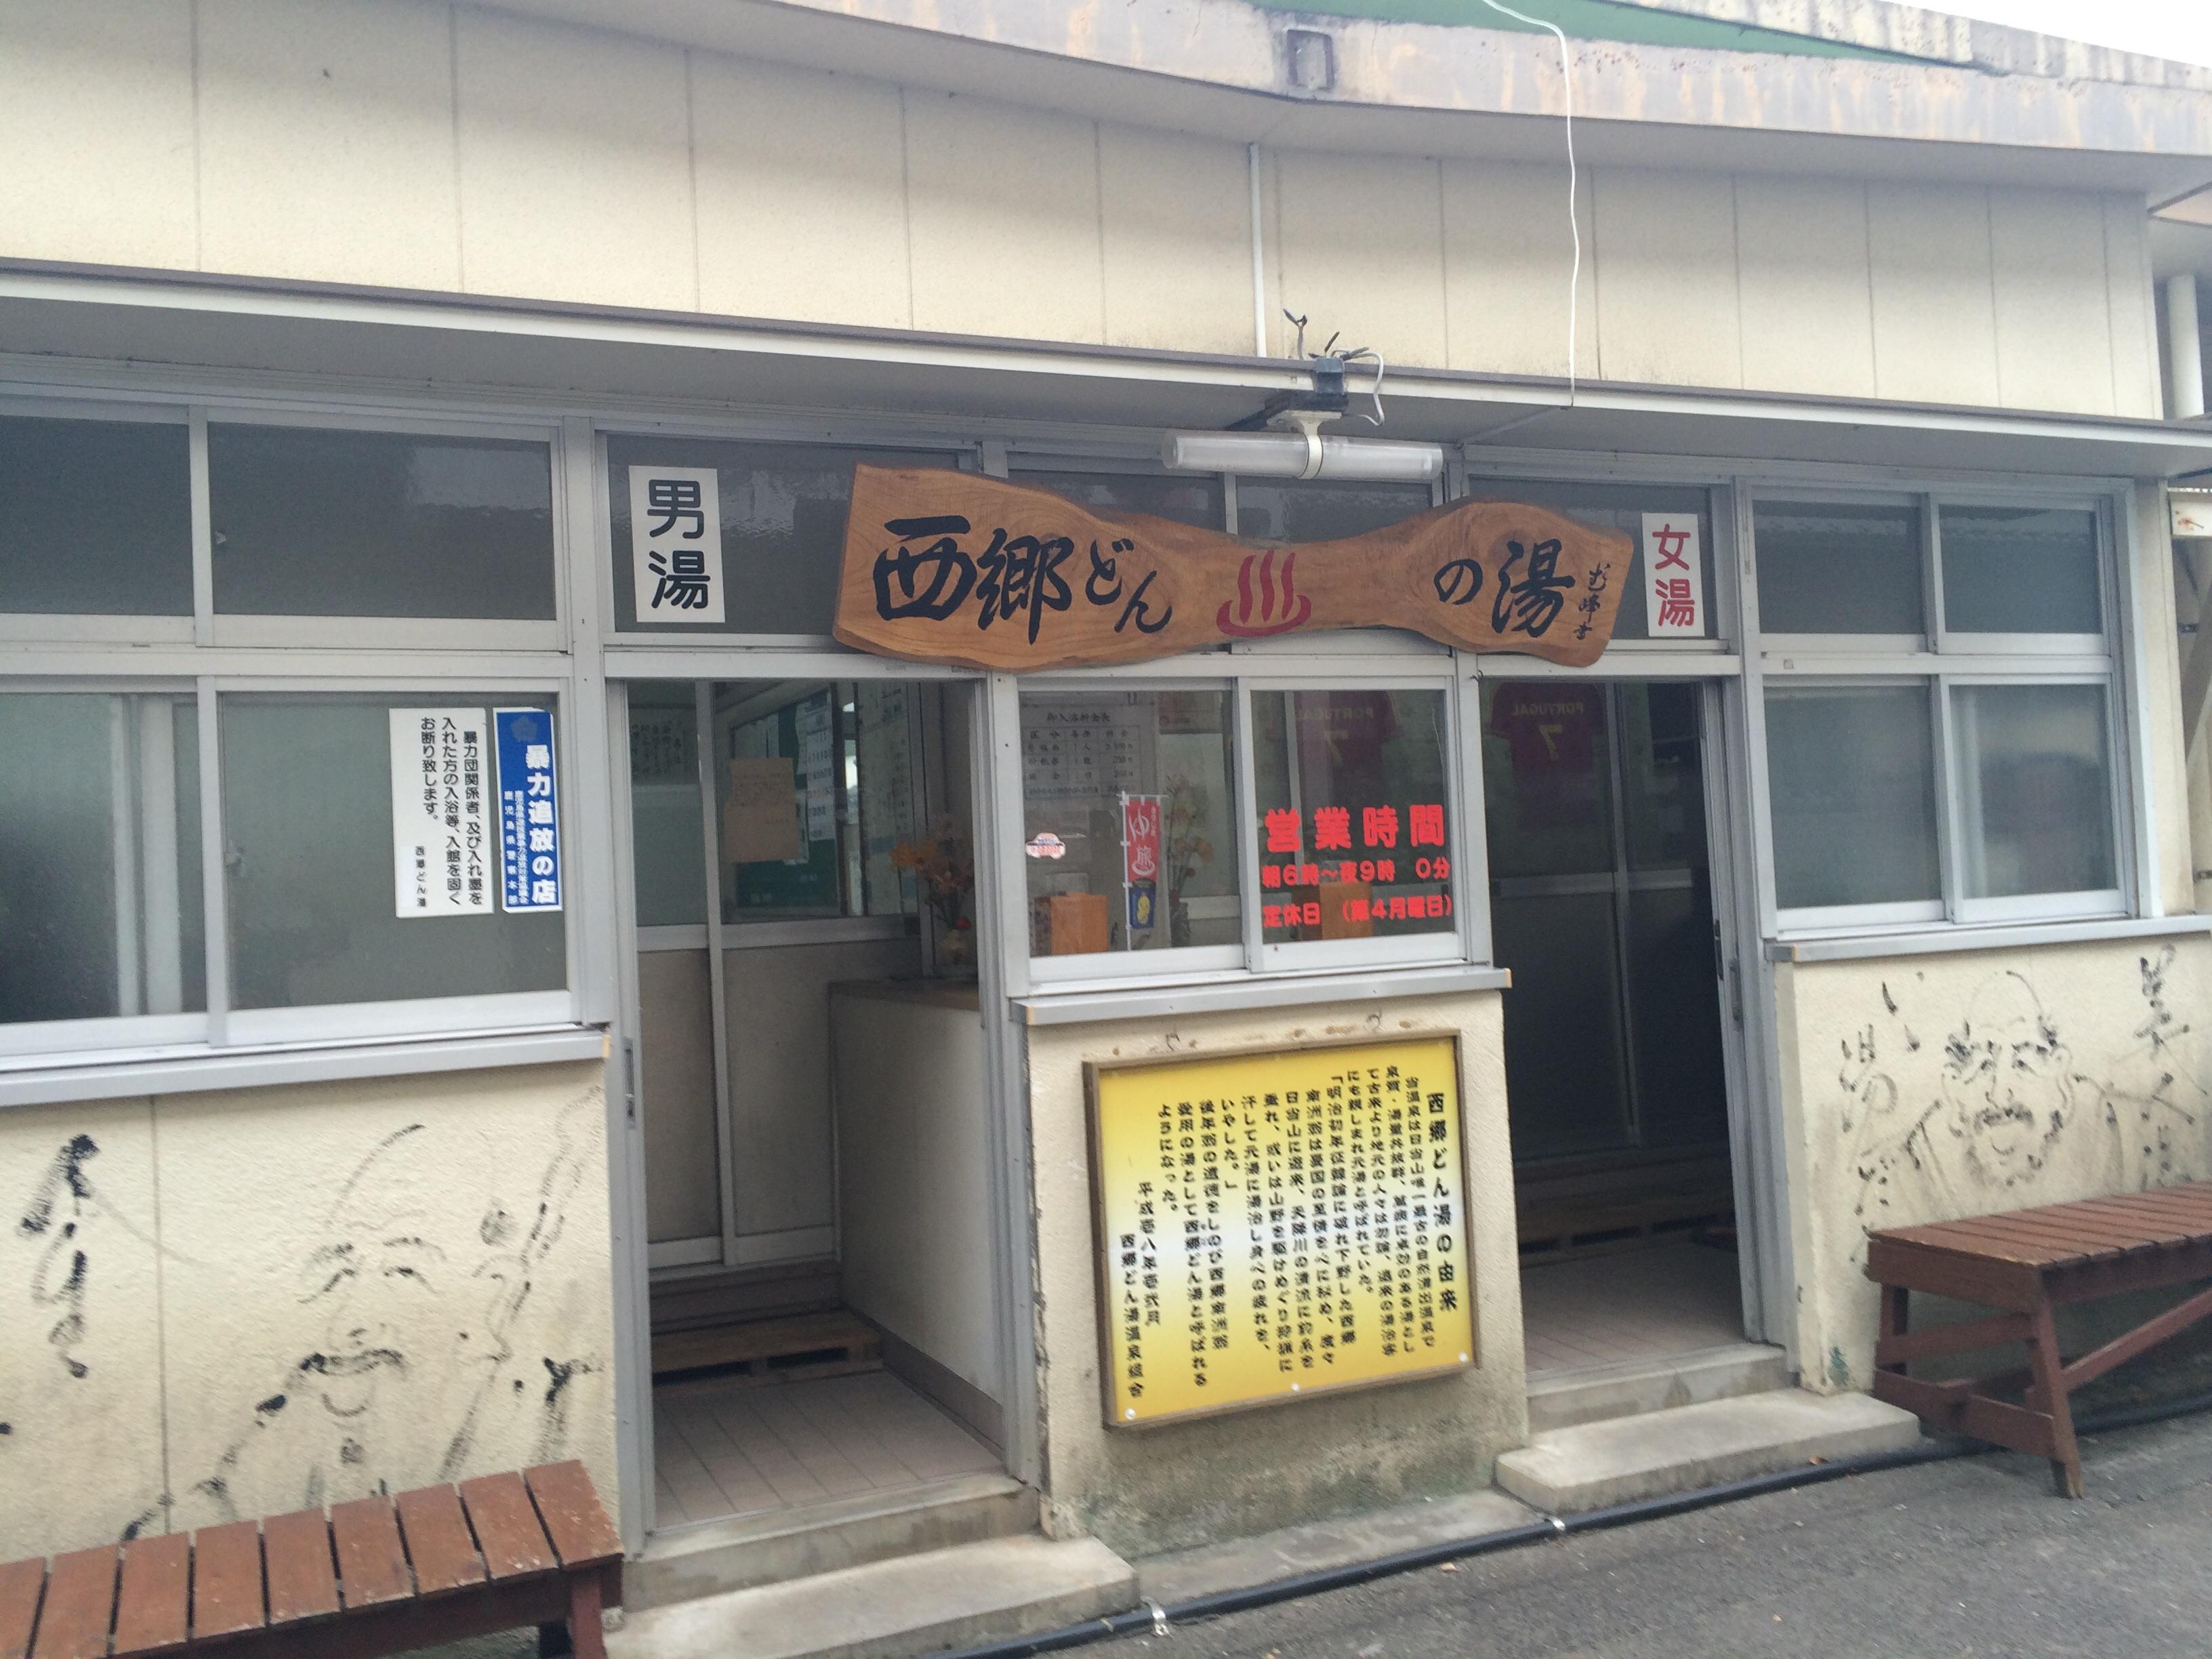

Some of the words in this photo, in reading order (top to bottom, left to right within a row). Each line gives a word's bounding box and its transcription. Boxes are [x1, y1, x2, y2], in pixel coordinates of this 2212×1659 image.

[647, 479, 711, 611] 男湯
[872, 515, 1173, 644] 西郷どん
[1433, 538, 1576, 637] の湯
[1652, 523, 1696, 628] 女湯
[421, 717, 438, 820] お断り致します。
[442, 717, 462, 905] 入れた方の入浴等、入館を固く
[526, 744, 556, 904] 暴力追放の店
[1265, 804, 1445, 853] 営業時間
[1263, 902, 1321, 928] 定休日
[1158, 1104, 1178, 1212] ようになった。
[1427, 1092, 1458, 1312] 西郷どん湯の由来
